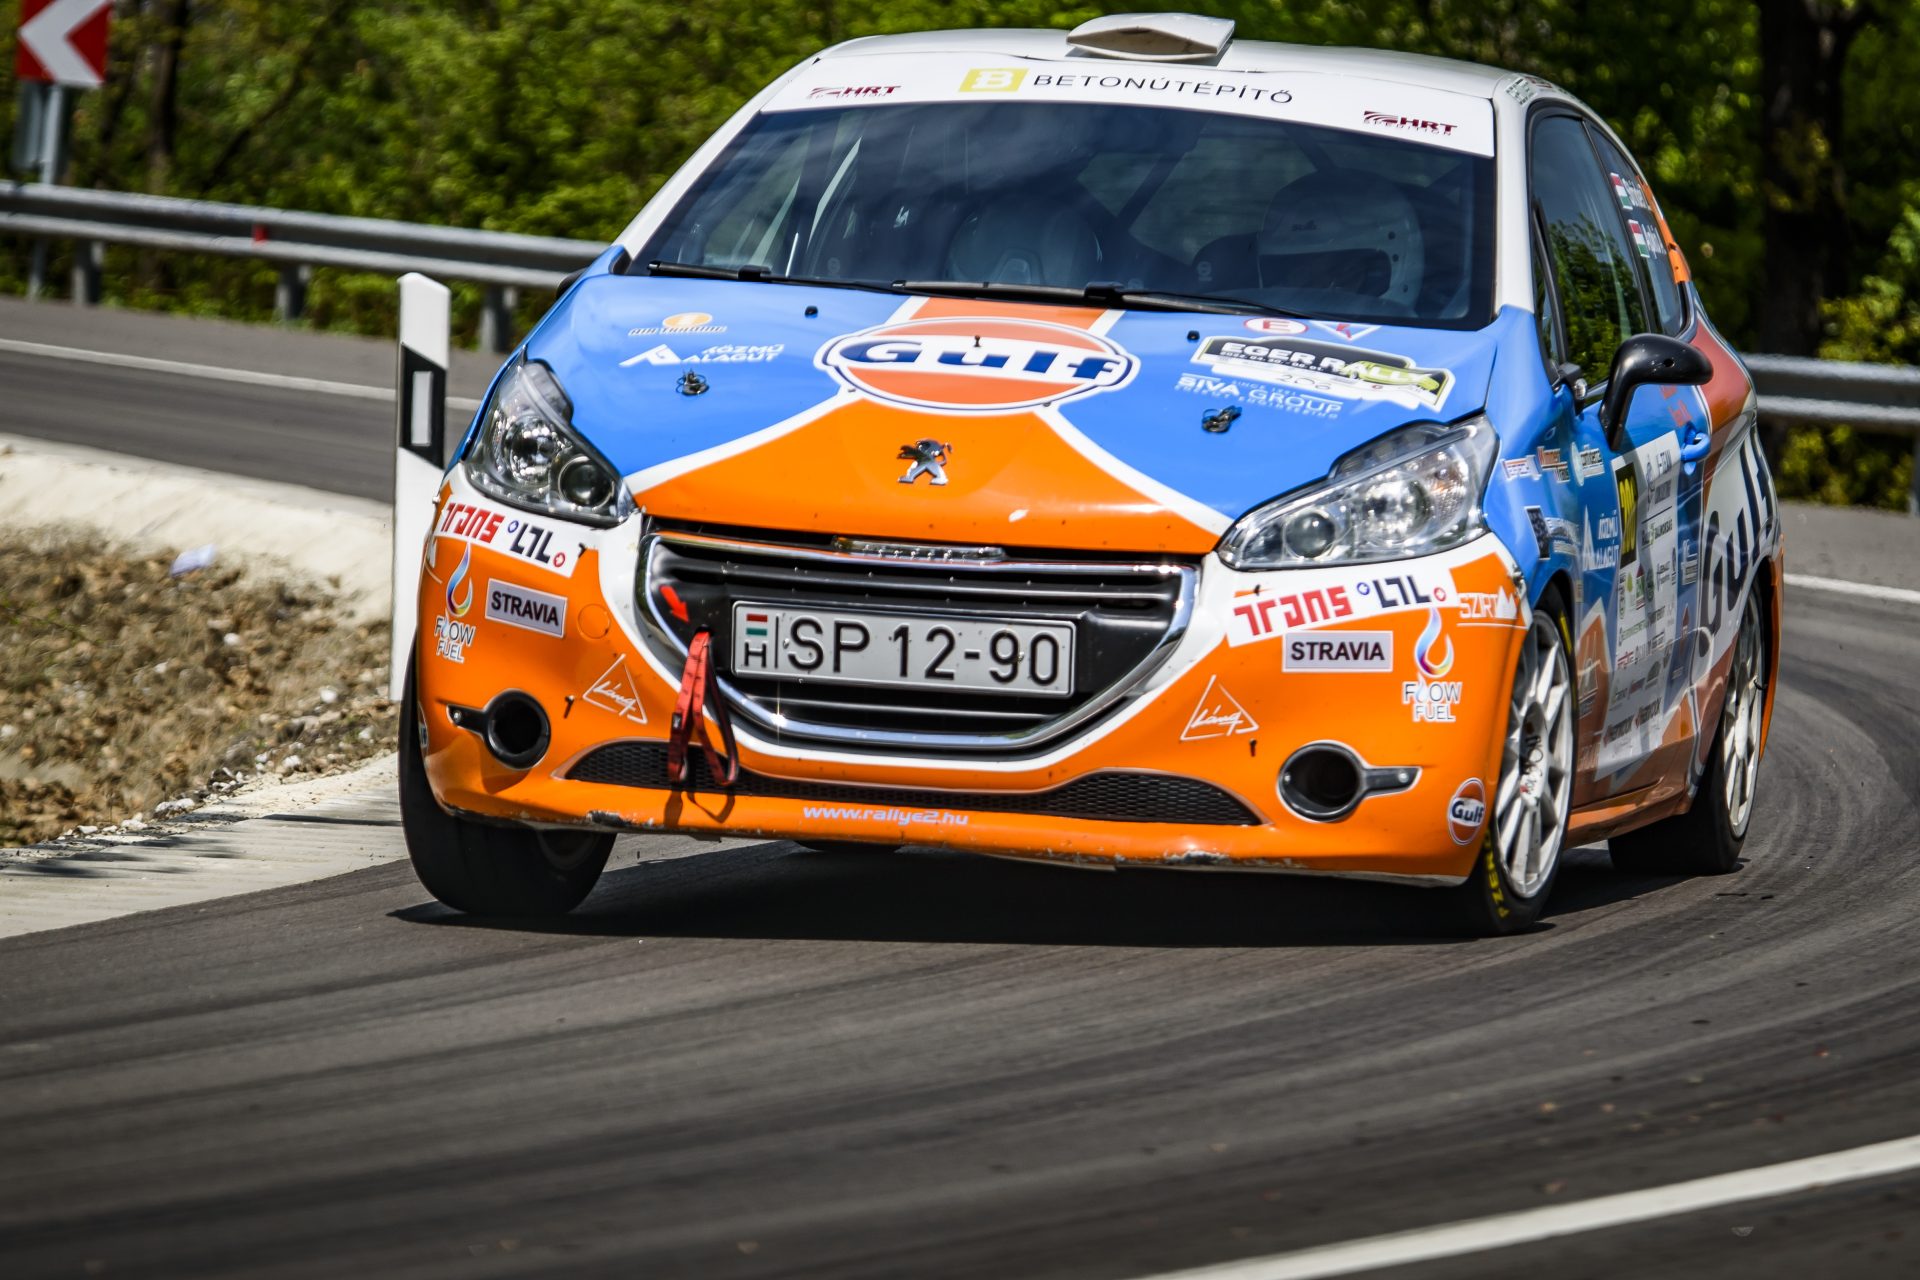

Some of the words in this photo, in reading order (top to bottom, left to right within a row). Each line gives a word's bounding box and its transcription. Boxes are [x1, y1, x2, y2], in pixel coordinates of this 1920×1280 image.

[843, 85, 901, 96] HRT
[1033, 73, 1293, 104] BETONÚTÉPÍTŐ
[1399, 116, 1457, 132] HRT
[838, 340, 1122, 380] Gulf
[1220, 342, 1316, 366] EGER
[1319, 356, 1434, 383] RALLY
[1177, 376, 1240, 396] SIVA
[1248, 388, 1343, 413] GROUP
[491, 591, 559, 626] STRAVIA
[436, 638, 465, 663] FUEL
[742, 639, 768, 669] H
[787, 616, 871, 673] SP
[890, 624, 1061, 686] 12-90
[1290, 640, 1386, 662] STRAVIA
[1413, 703, 1456, 722] FUEL
[1451, 800, 1485, 826] Gulf
